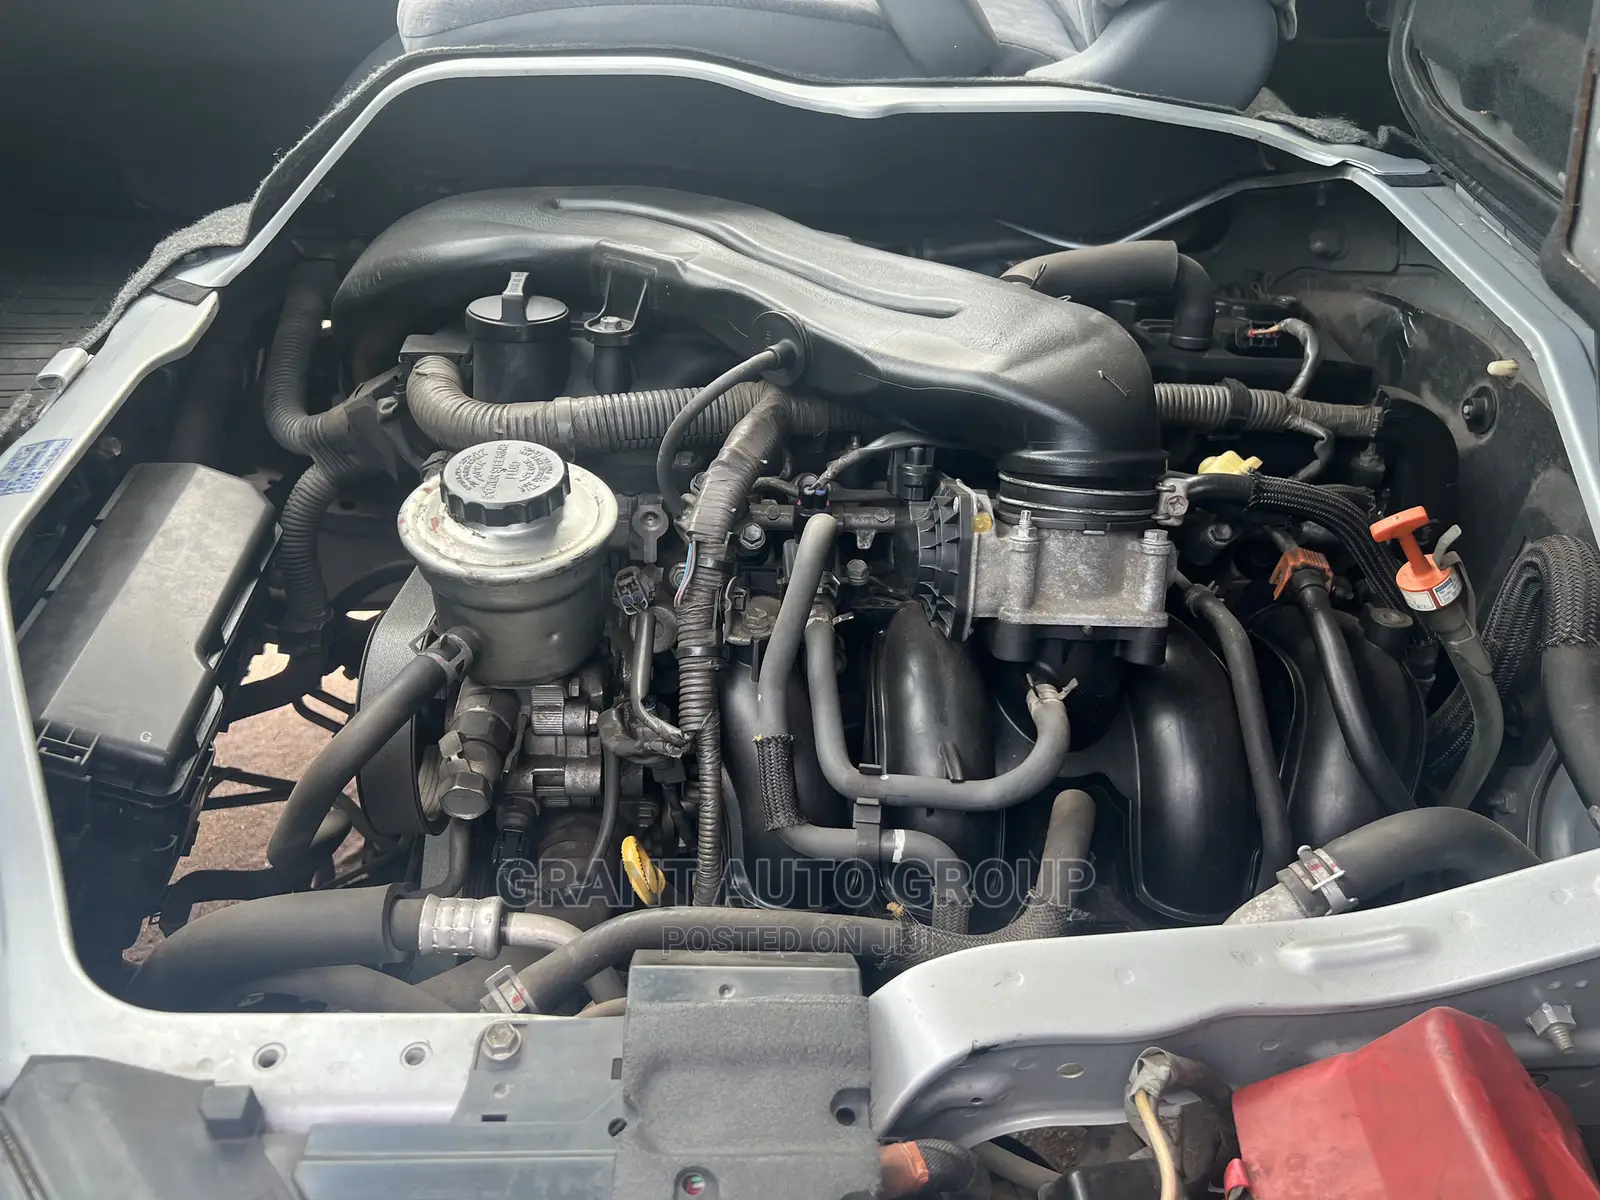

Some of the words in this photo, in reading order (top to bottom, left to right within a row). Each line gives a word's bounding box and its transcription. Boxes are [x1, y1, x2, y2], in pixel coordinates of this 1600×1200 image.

[482, 473, 500, 499] POWER
[491, 443, 509, 473] STEERING
[505, 461, 520, 480] FLUID
[139, 731, 152, 743] G
